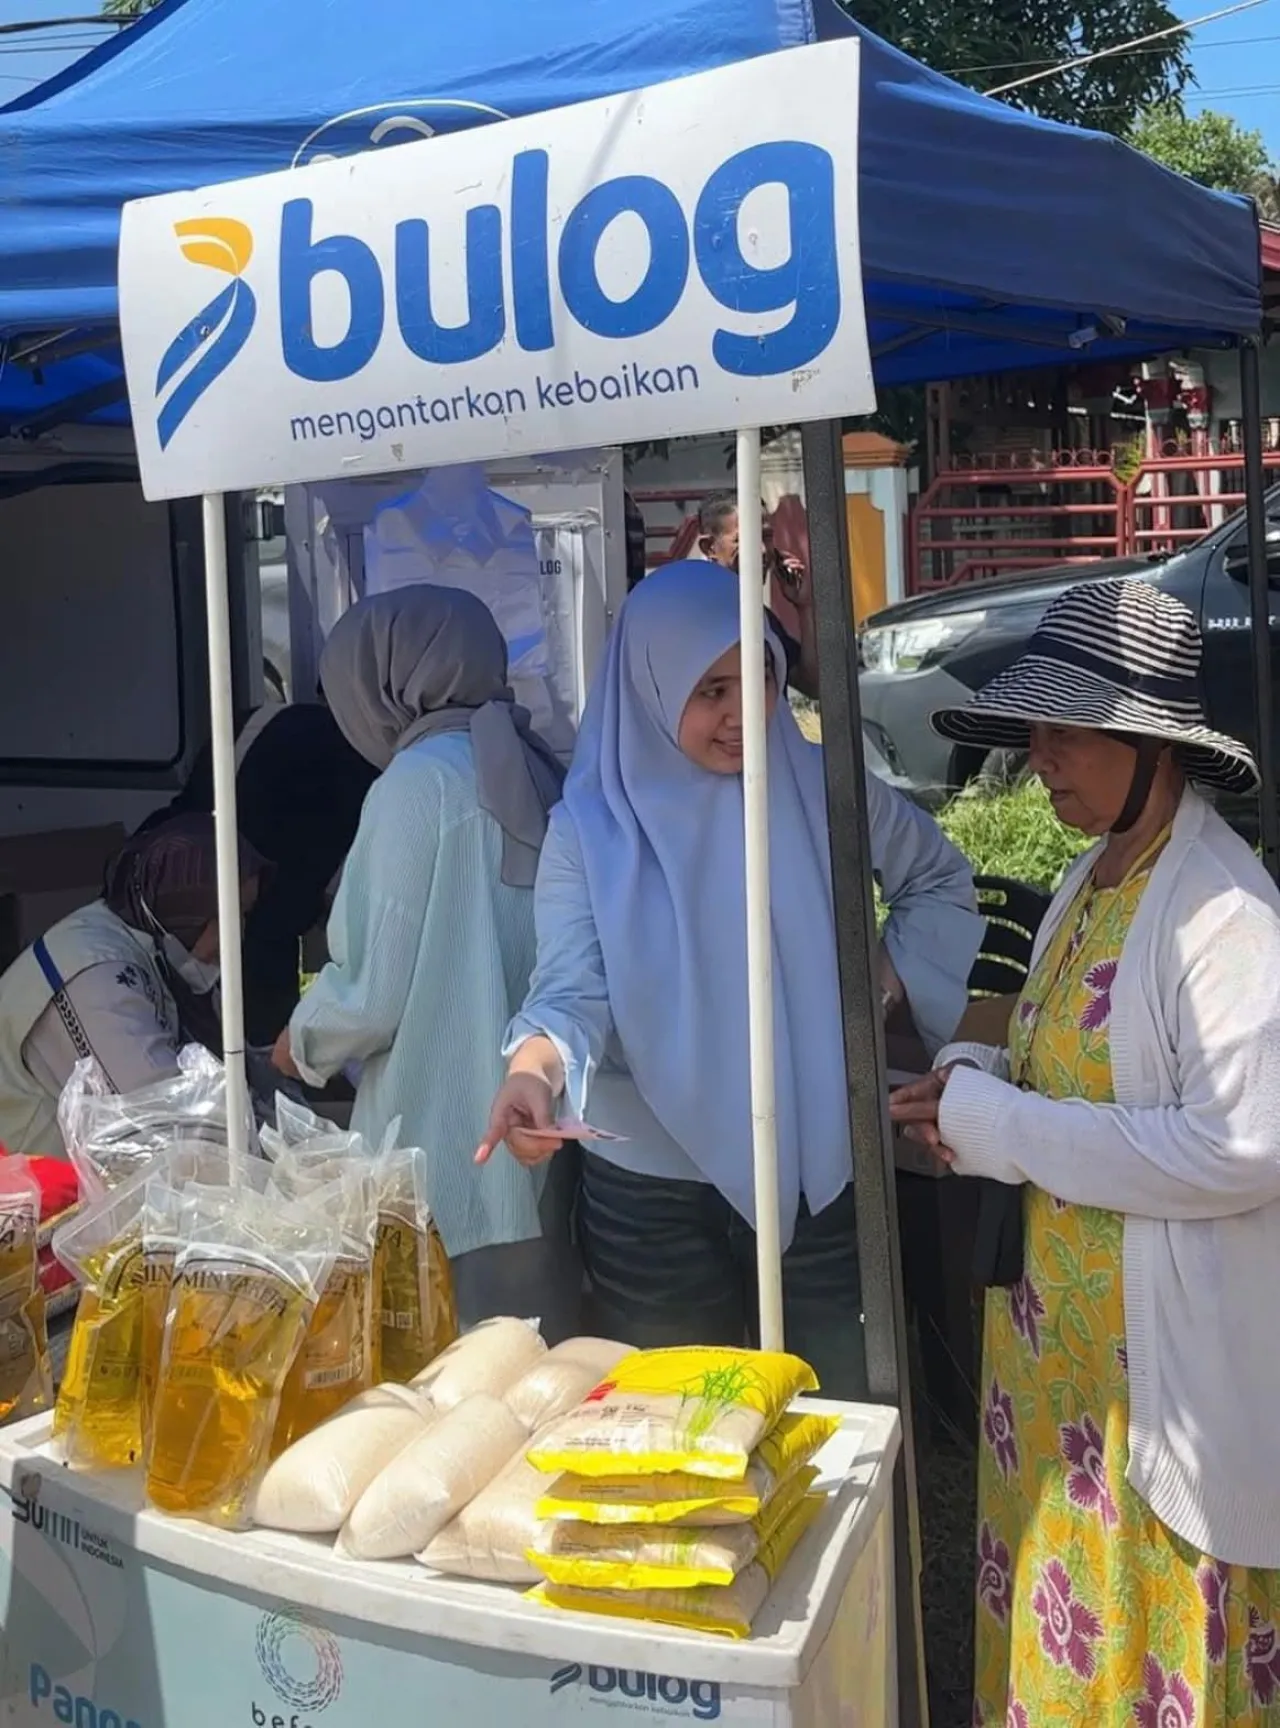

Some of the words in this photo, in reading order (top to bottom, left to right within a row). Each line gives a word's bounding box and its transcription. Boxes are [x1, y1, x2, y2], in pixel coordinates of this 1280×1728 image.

[279, 139, 841, 383] bulog
[289, 385, 527, 442] mengantarkan
[536, 362, 701, 410] kebaikan
[251, 1701, 313, 1728] bef
